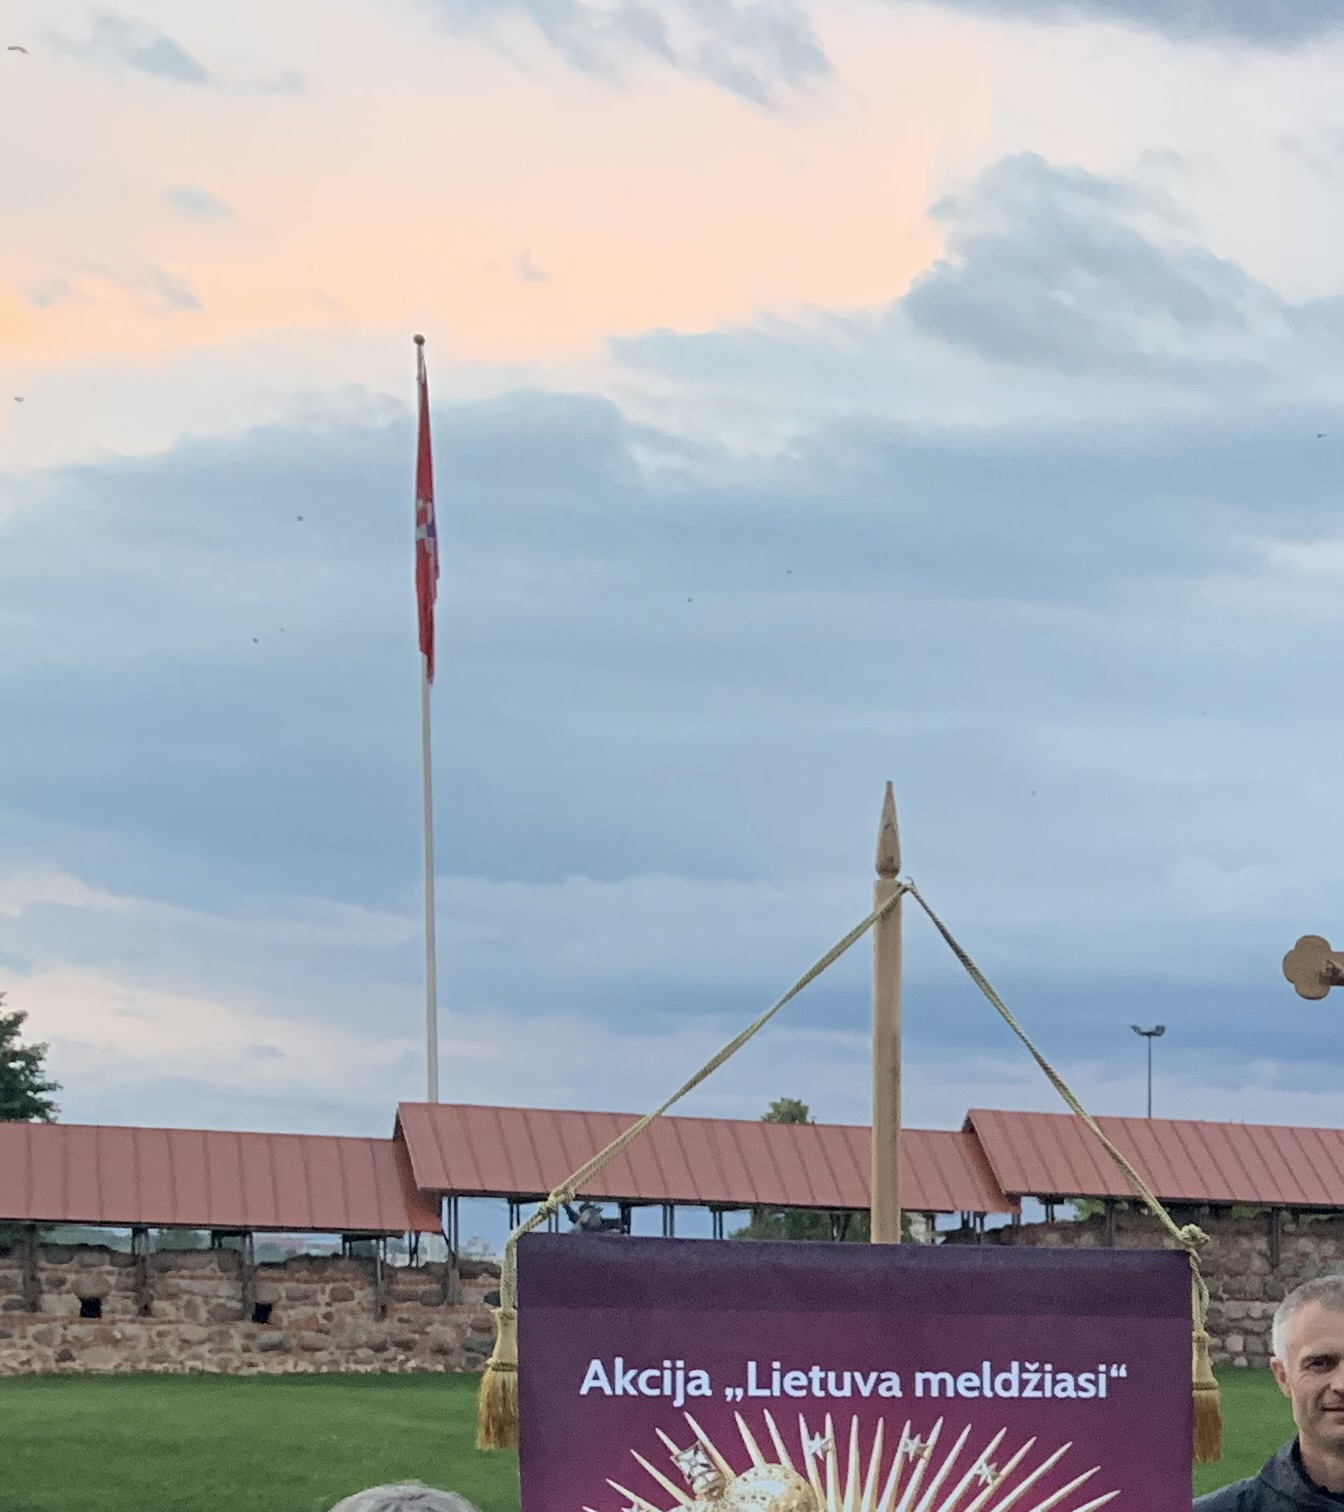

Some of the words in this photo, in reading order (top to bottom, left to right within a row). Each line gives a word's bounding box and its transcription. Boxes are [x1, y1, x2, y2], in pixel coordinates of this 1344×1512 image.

[579, 1358, 713, 1408] Akcija
[724, 1359, 903, 1402] „Lietuva
[914, 1360, 1128, 1399] meldžiasi“
